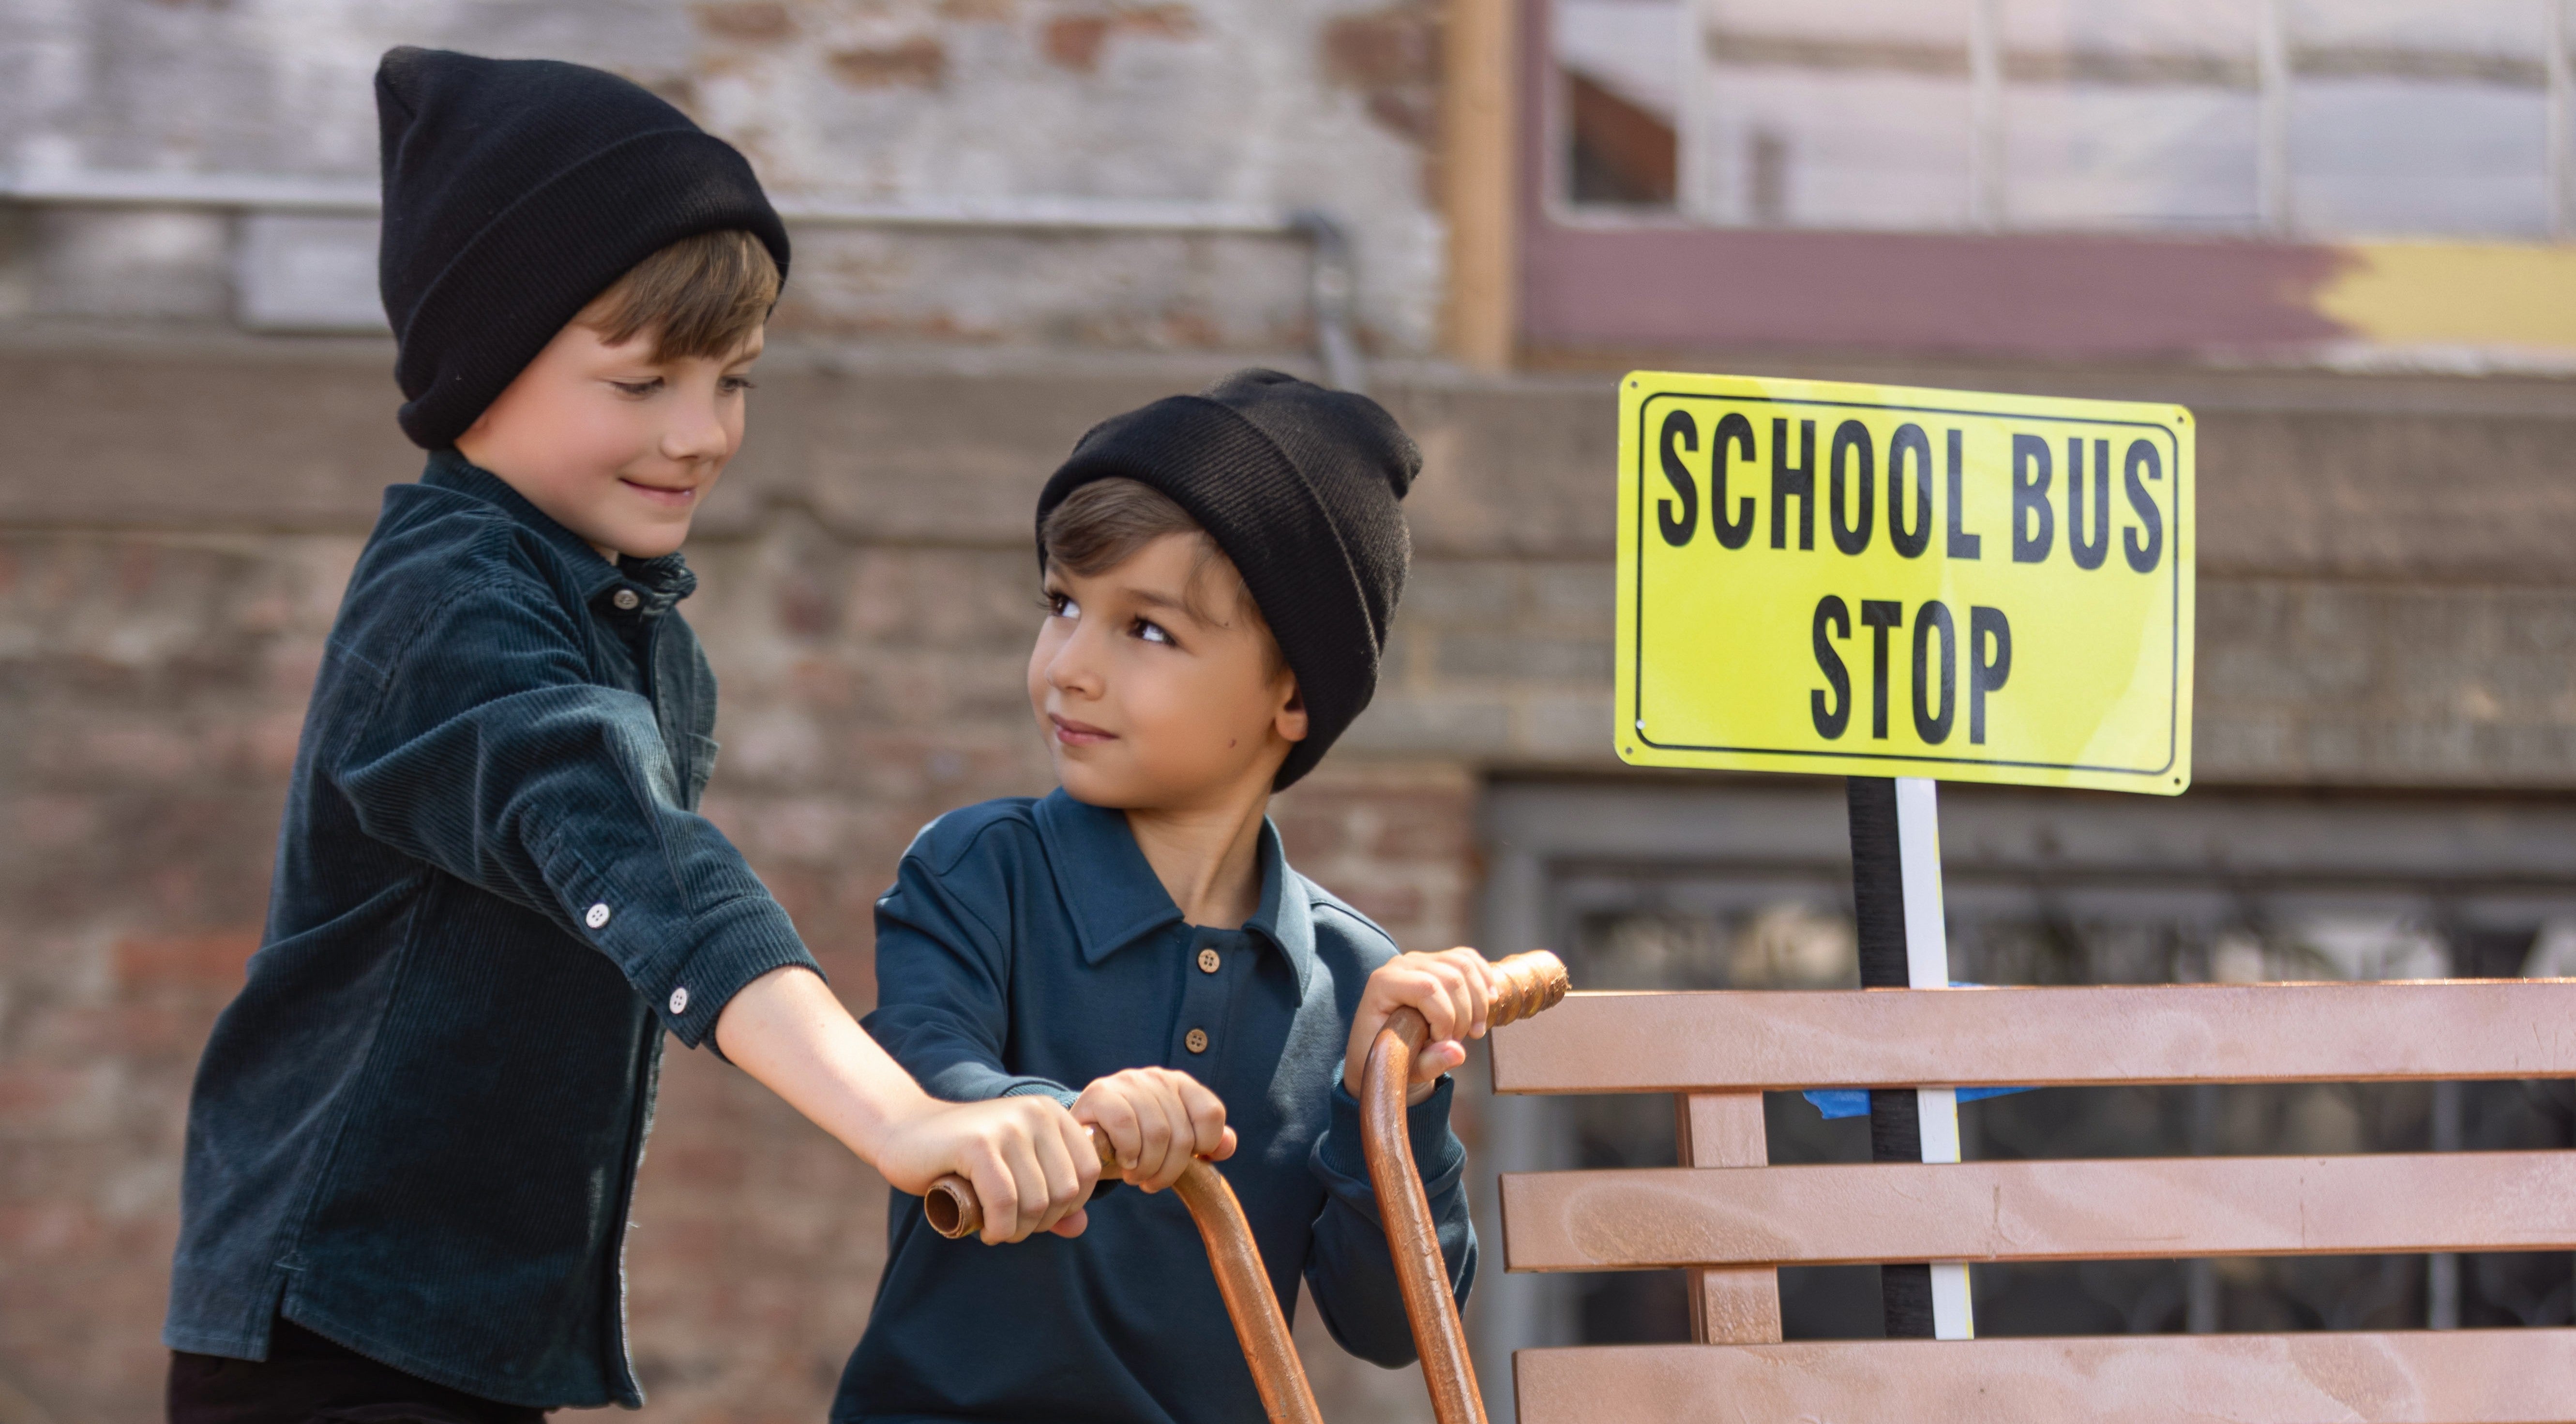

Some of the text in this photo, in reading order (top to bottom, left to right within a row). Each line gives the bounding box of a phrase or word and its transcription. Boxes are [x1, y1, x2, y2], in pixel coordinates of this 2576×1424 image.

[1656, 409, 2163, 574] SCHOOL BUS
[1810, 594, 2012, 746] STOP
